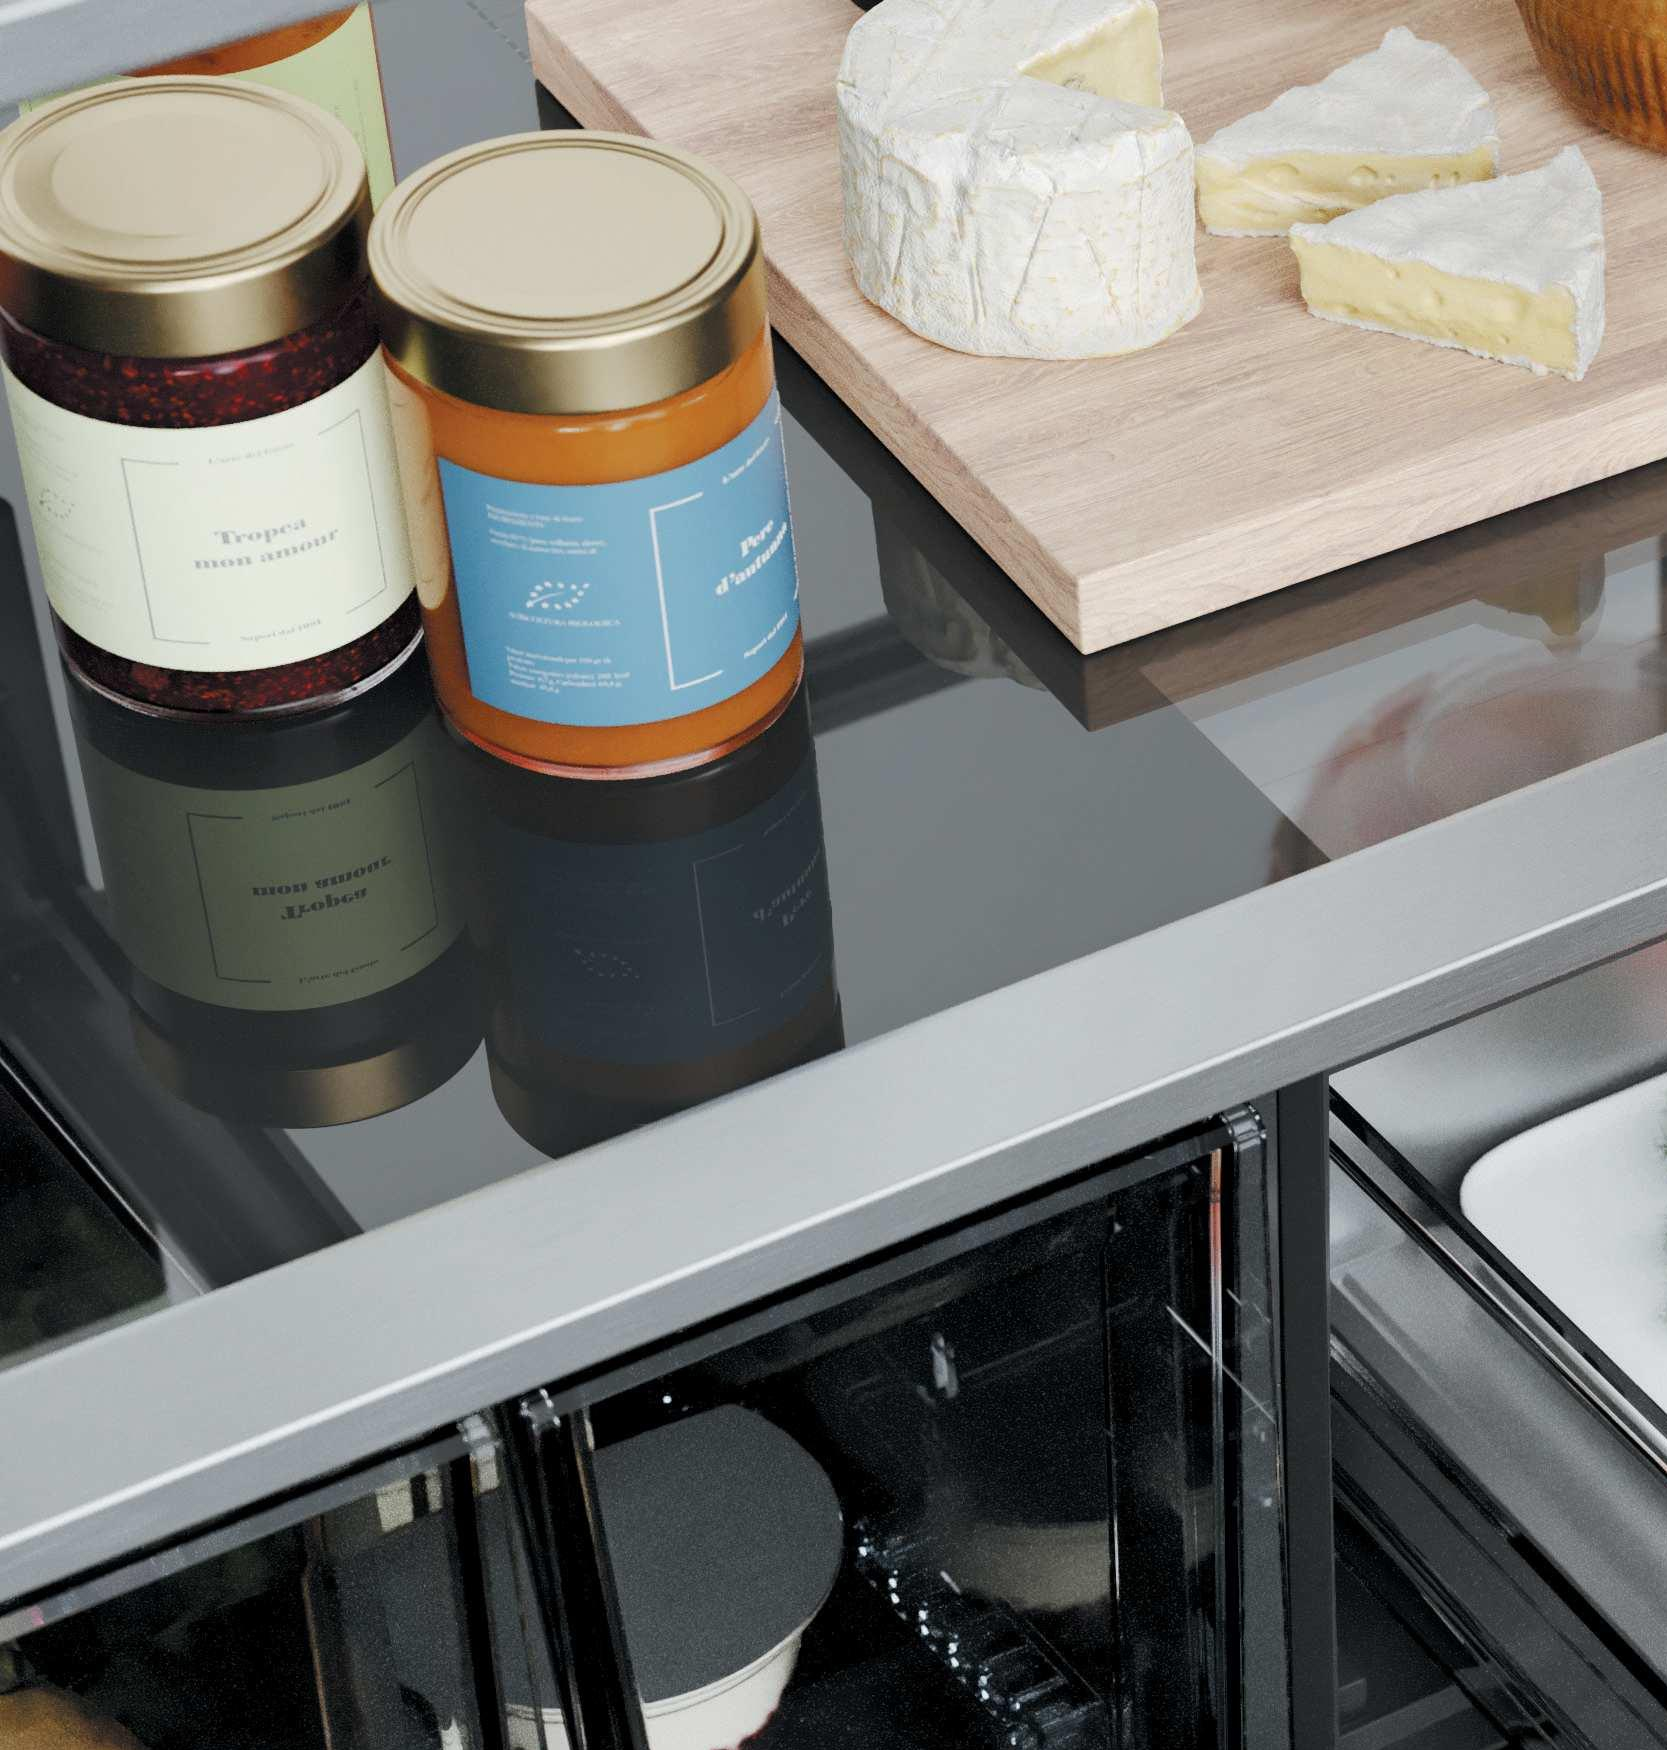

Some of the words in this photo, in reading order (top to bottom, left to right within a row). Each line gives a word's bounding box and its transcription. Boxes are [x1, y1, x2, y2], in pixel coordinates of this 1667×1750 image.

[214, 518, 307, 545] Tropea
[193, 555, 253, 570] mon
[260, 528, 340, 564] amour
